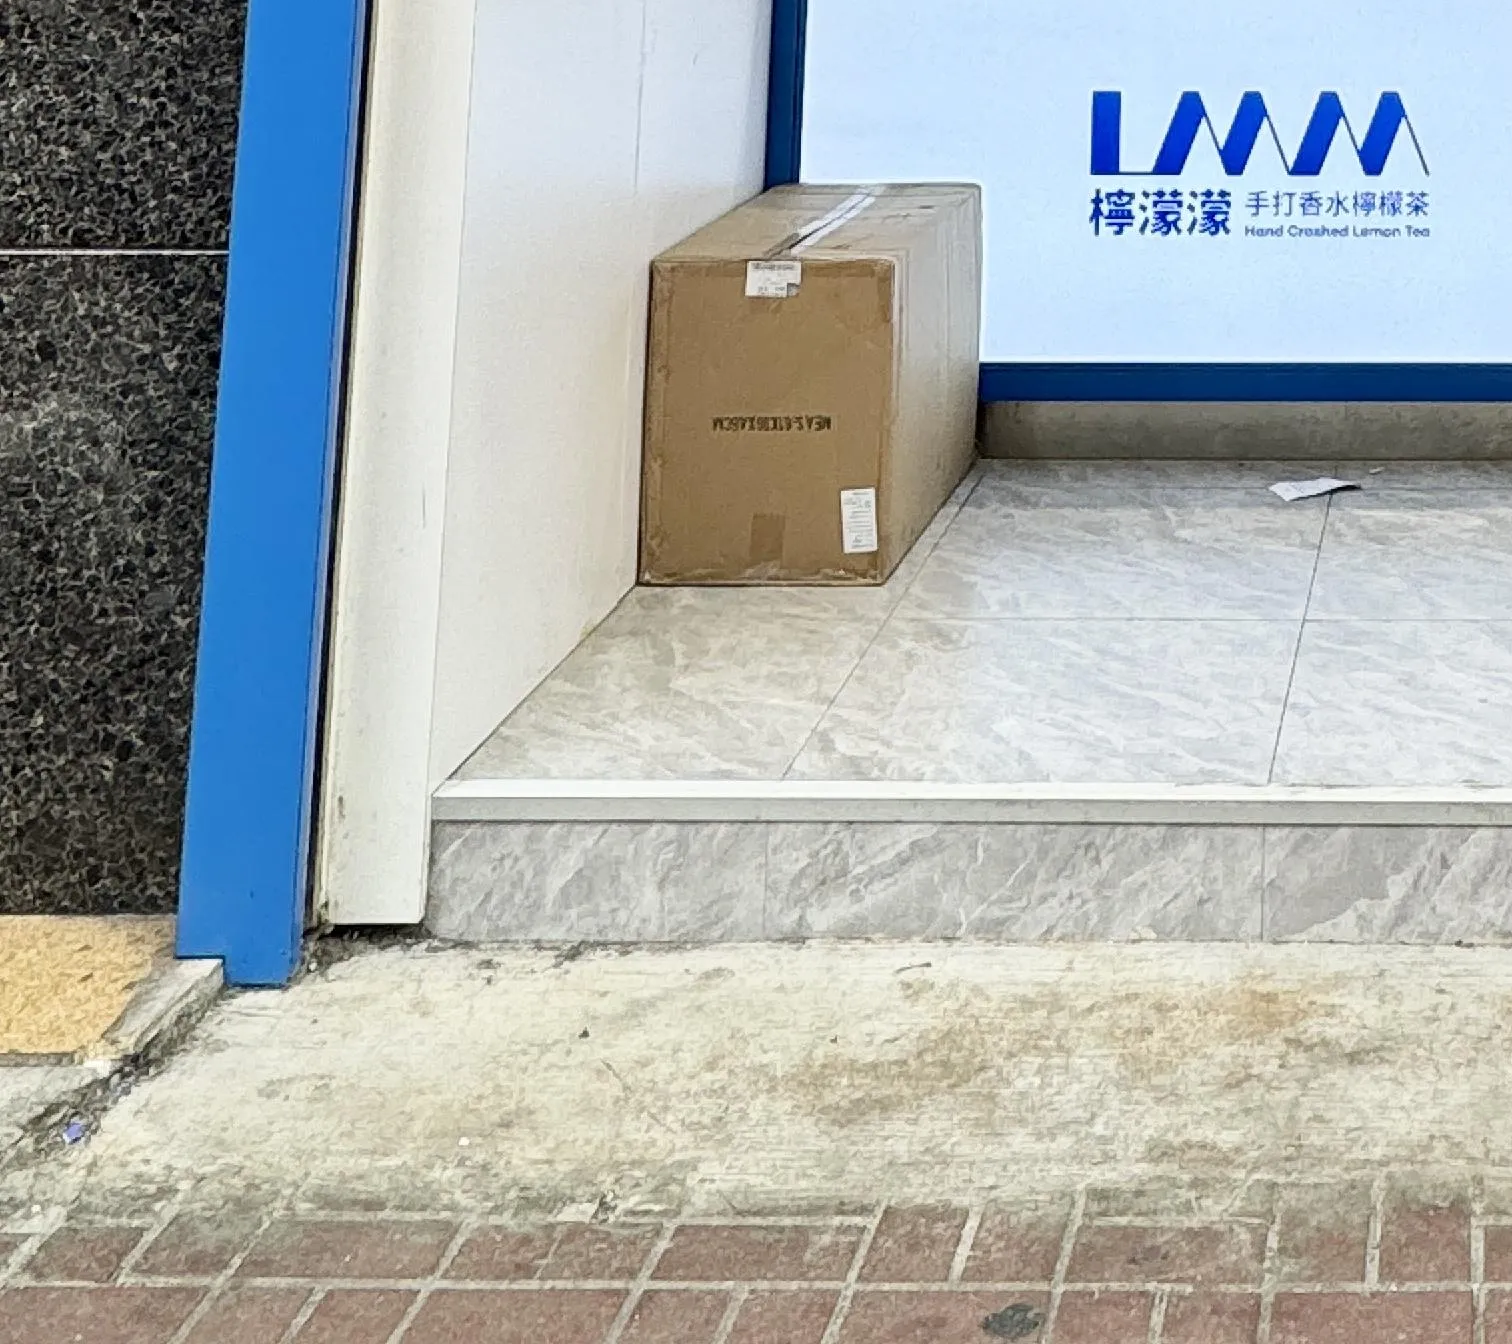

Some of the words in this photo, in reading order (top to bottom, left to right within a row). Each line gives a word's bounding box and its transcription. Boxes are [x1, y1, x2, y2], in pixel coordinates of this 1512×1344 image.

[1090, 189, 1231, 236] 檸濛濛
[1245, 190, 1430, 217] 手打香水檸檬茶
[1245, 225, 1283, 238] Hand
[1353, 225, 1401, 238] Lemon
[1405, 225, 1430, 238] Tea
